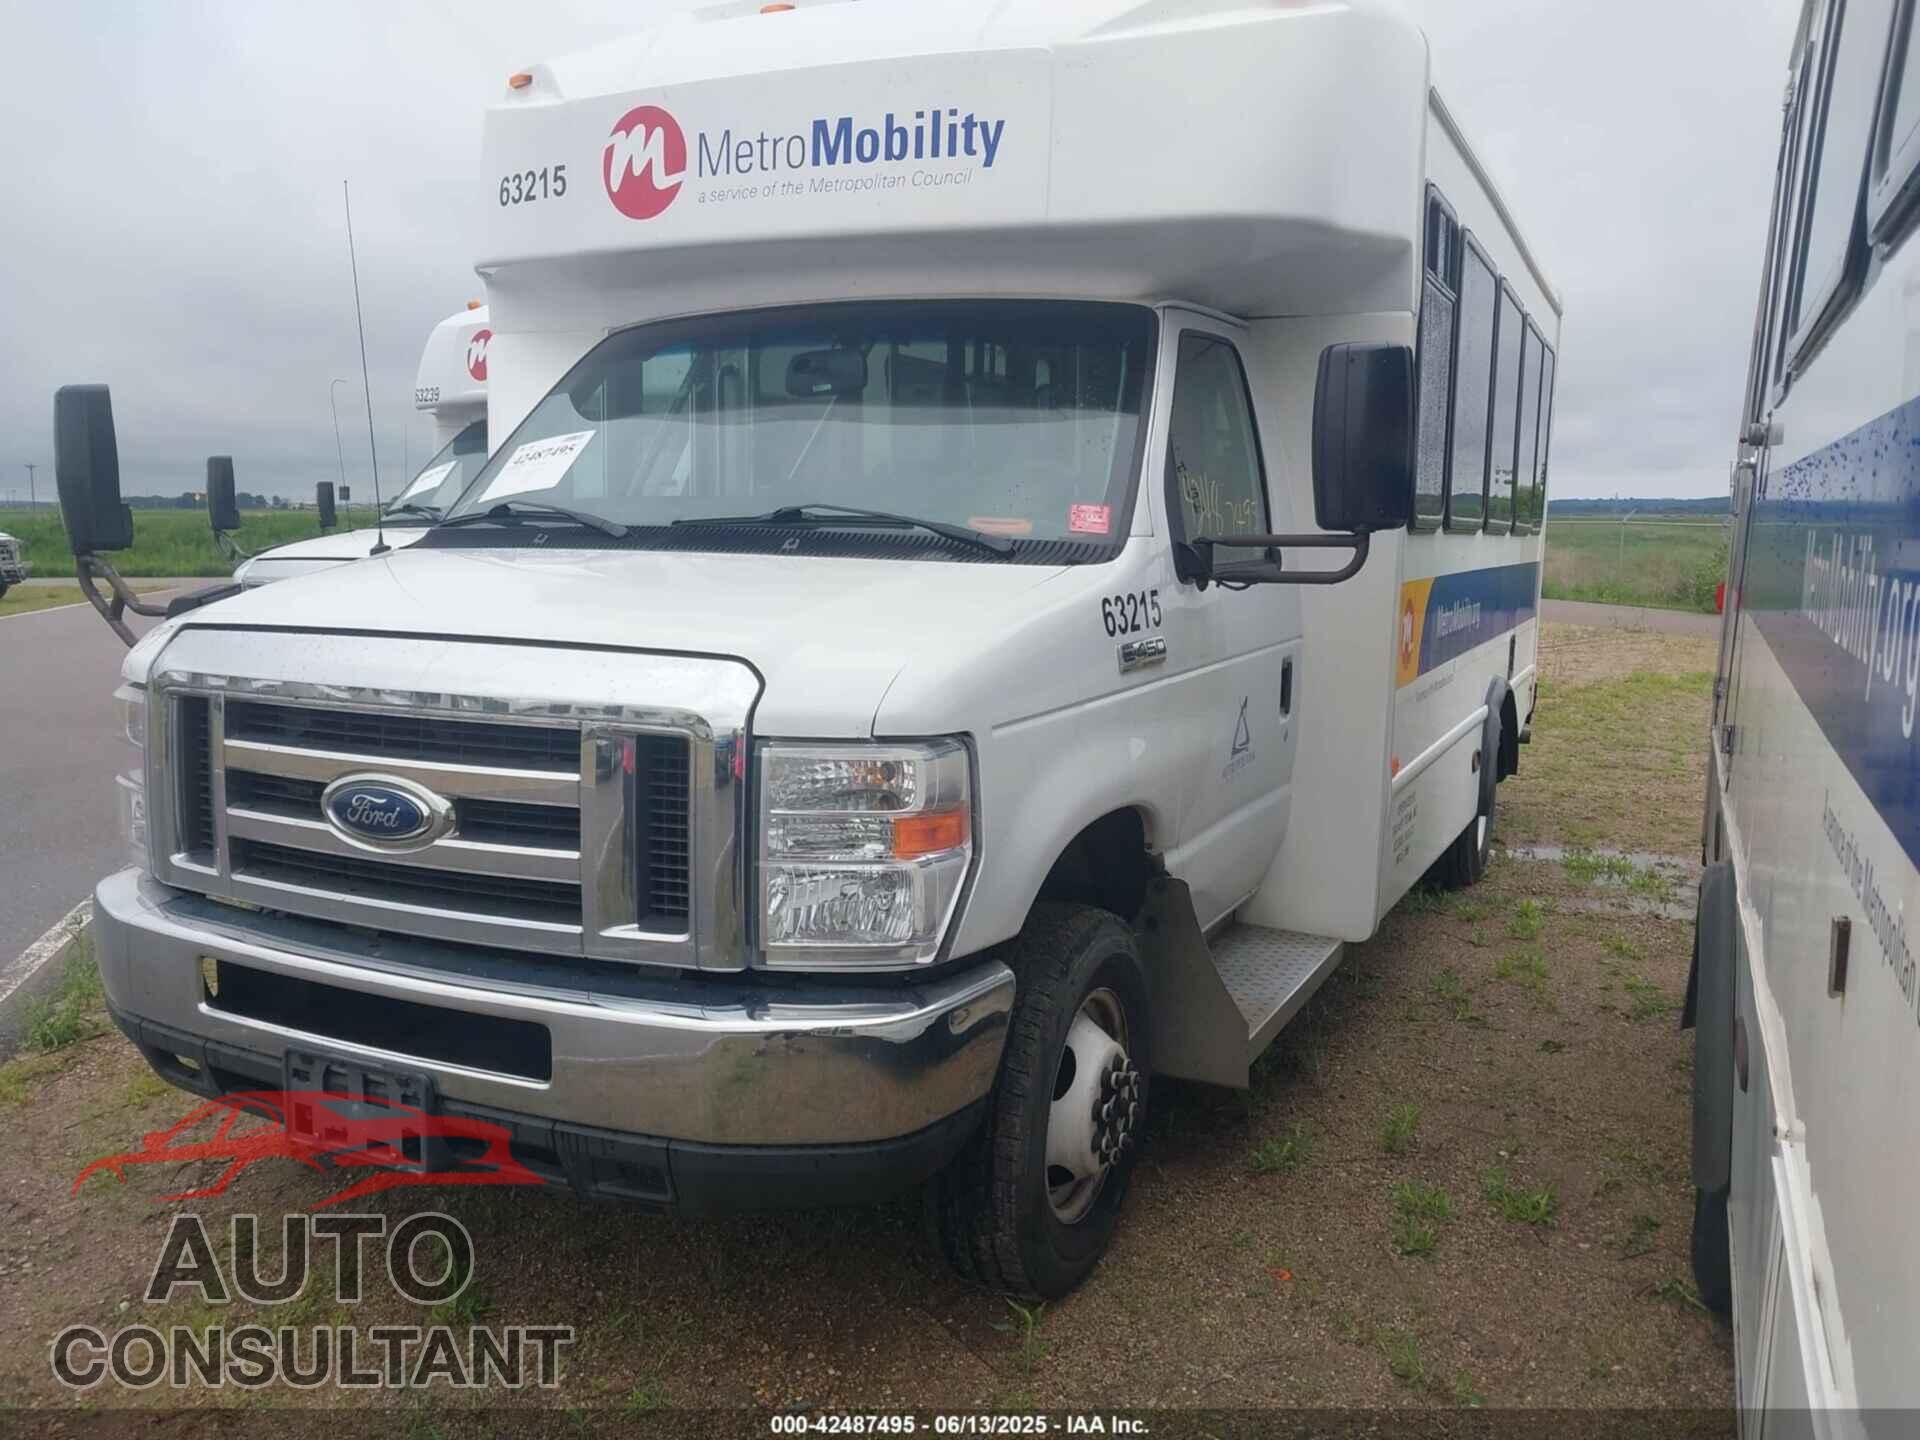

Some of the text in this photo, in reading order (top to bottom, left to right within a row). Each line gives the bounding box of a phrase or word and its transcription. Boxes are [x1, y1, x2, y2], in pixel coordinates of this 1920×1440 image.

[698, 109, 1006, 178] MetroMobility
[499, 164, 567, 207] 63215
[697, 167, 973, 204] a service of the Metropolitan Council
[1101, 589, 1162, 638] 63215
[346, 793, 401, 828] Ford
